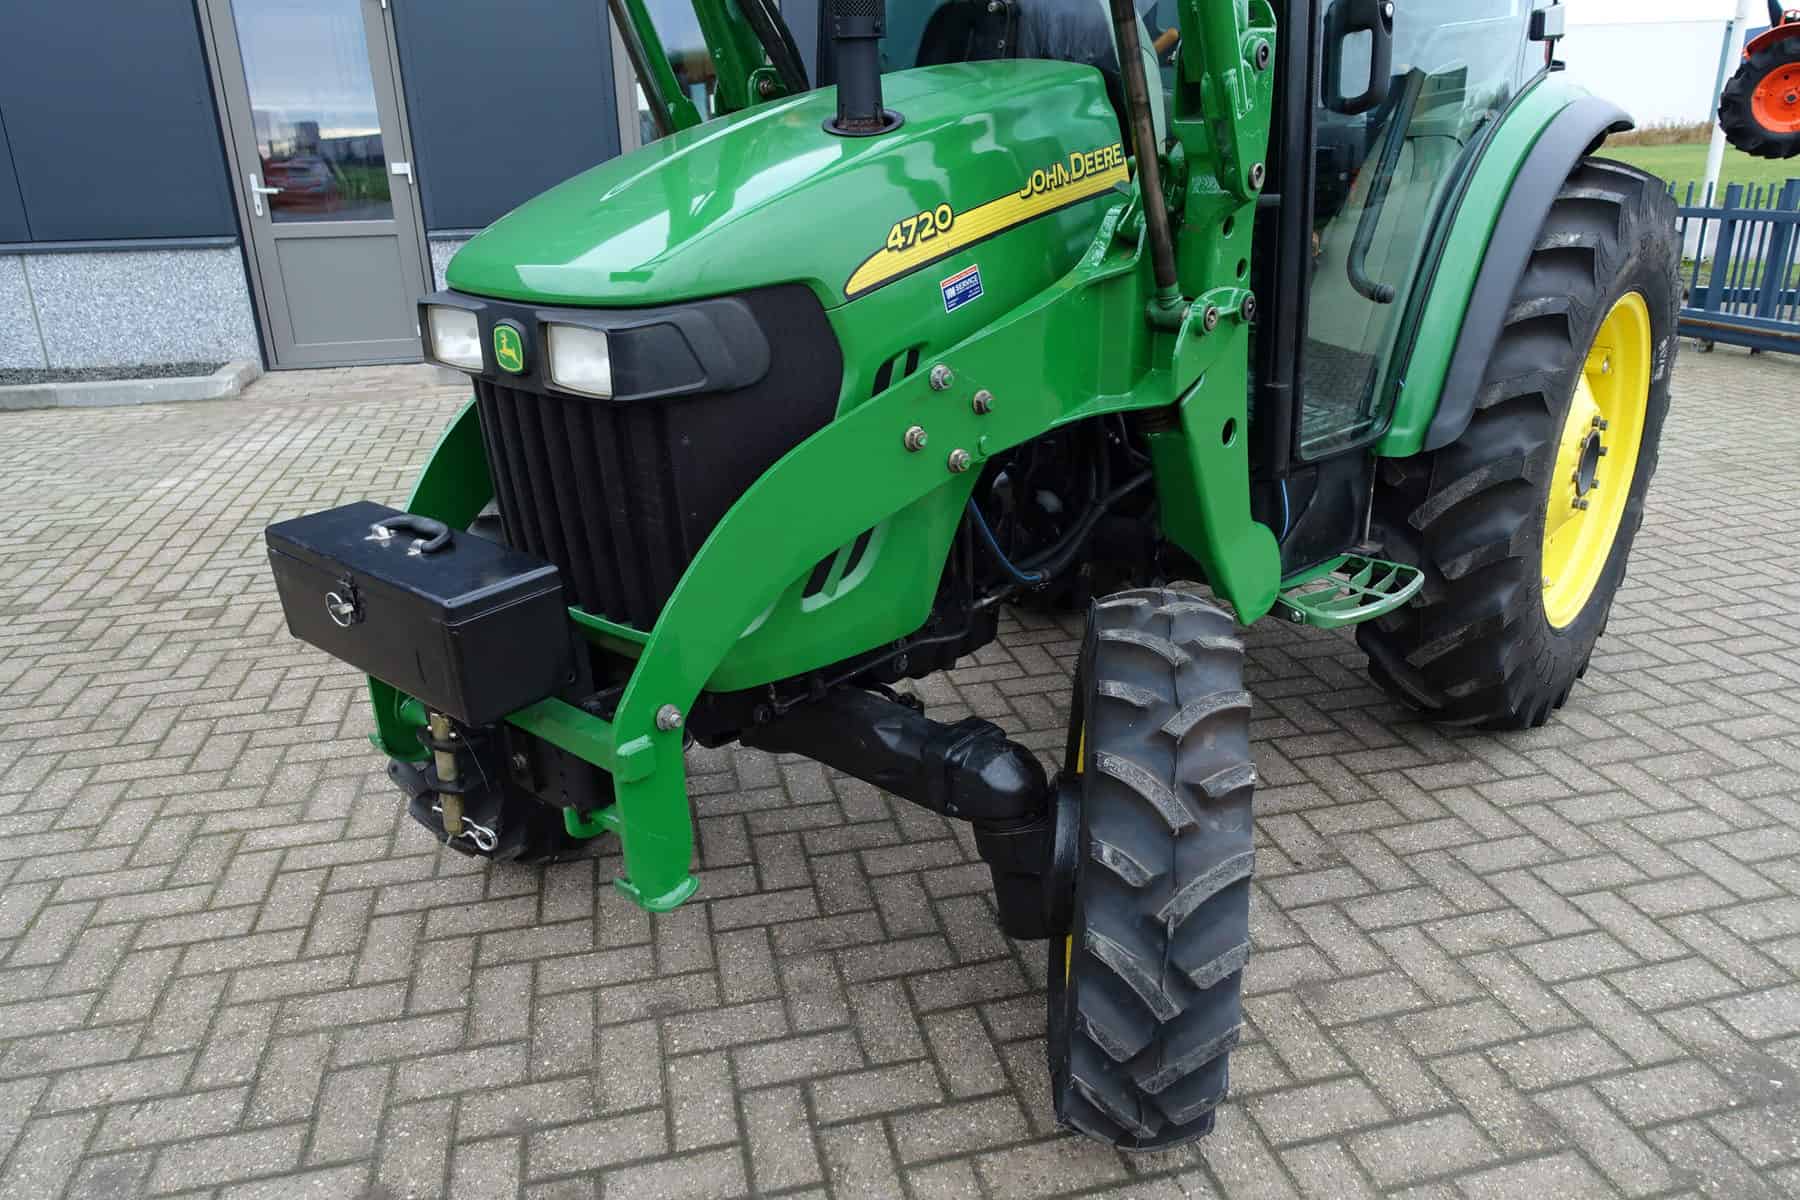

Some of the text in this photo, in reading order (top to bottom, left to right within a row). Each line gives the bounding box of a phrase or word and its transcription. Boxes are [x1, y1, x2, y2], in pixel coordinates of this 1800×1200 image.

[1020, 143, 1123, 199] JOHN DEERE
[887, 203, 953, 250] 4720
[955, 274, 978, 291] SERVICE
